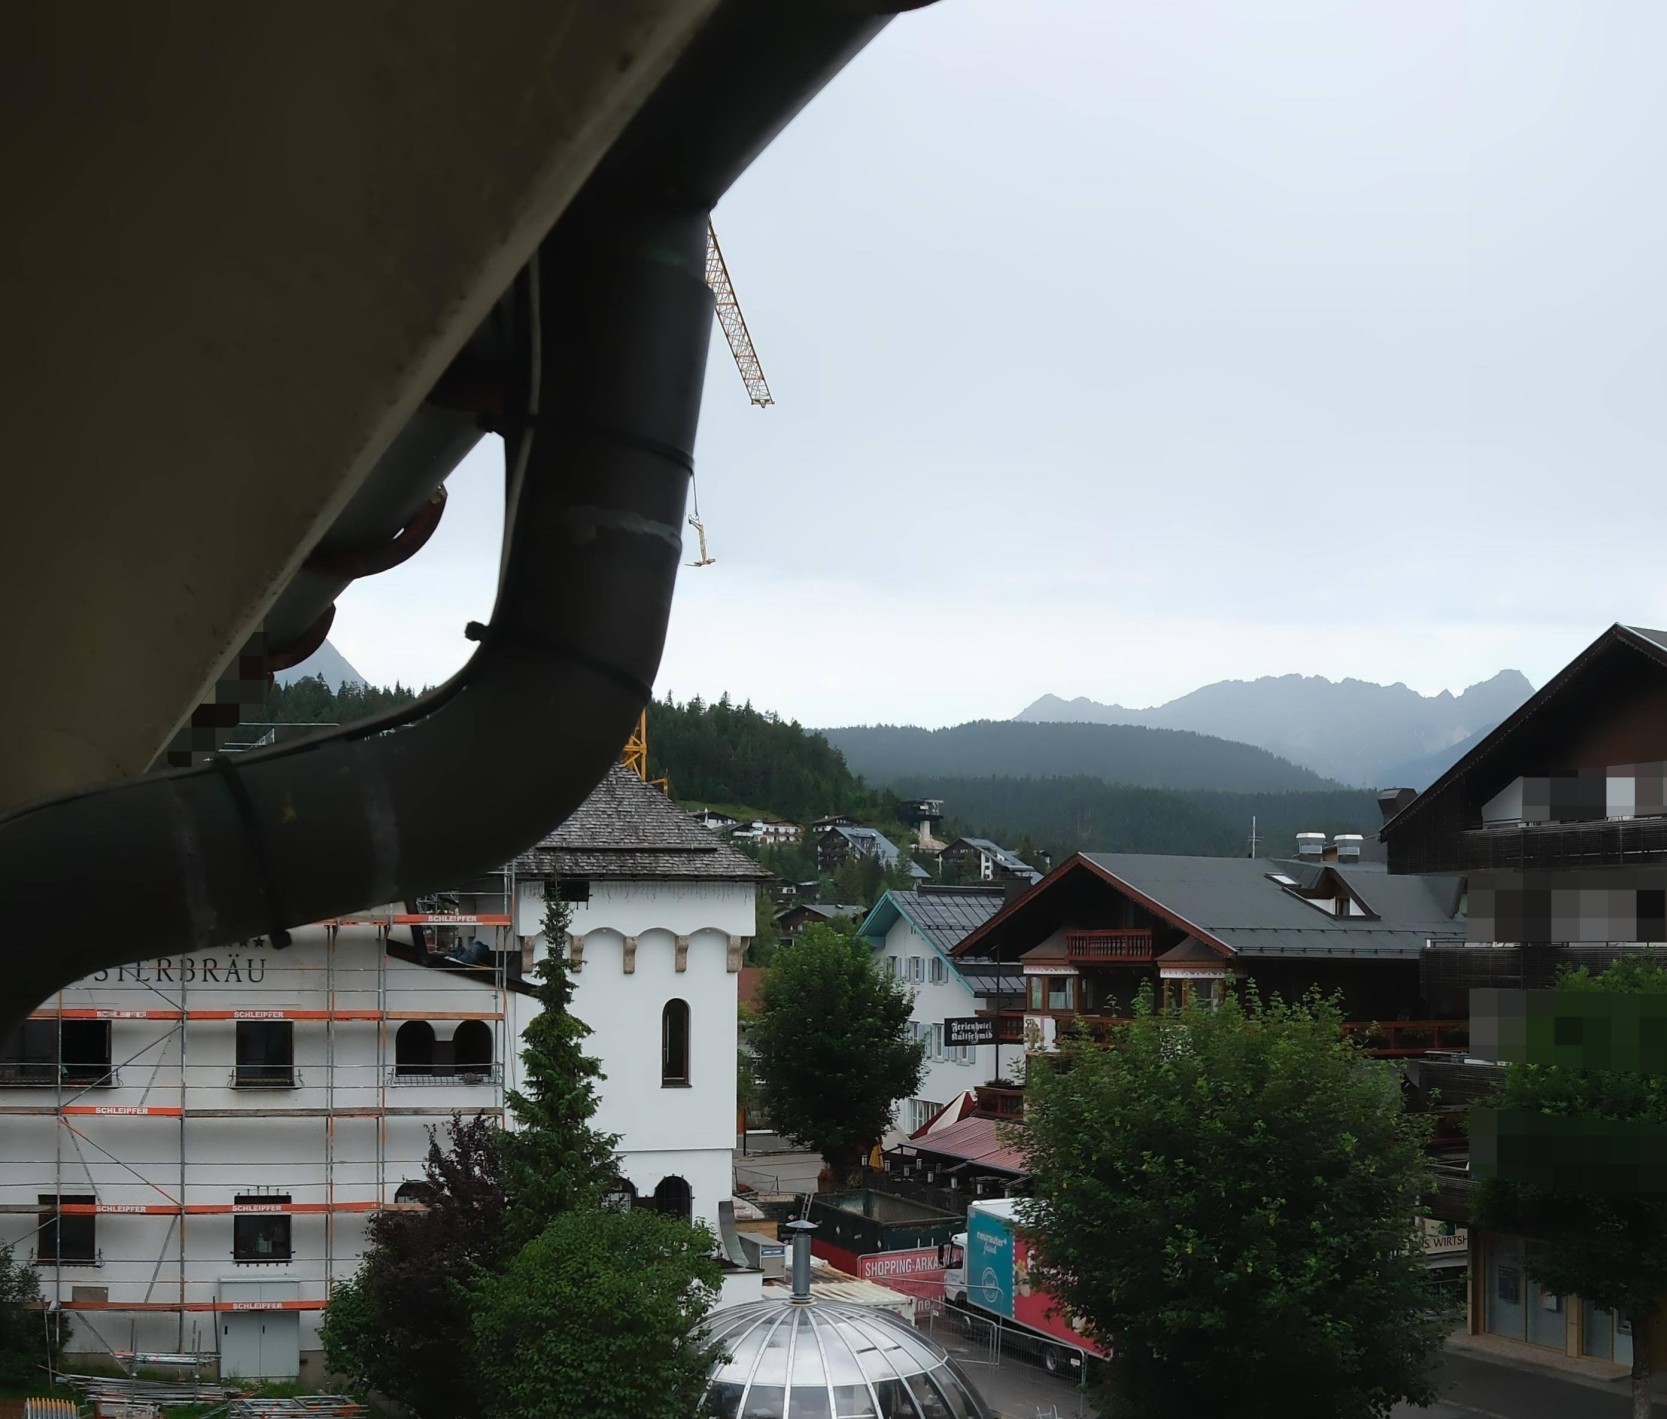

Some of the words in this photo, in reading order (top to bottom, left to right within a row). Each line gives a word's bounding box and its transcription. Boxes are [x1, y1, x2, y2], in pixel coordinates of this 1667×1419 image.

[88, 953, 267, 983] STERBRÄU
[233, 1011, 284, 1019] SCHLEIPFER
[95, 1107, 149, 1115] SCHLEIPFER
[96, 1205, 147, 1213] SCHLEIPFER
[231, 1204, 282, 1212] SCHLEIPFER
[232, 1301, 283, 1310] SCHLEIPFER
